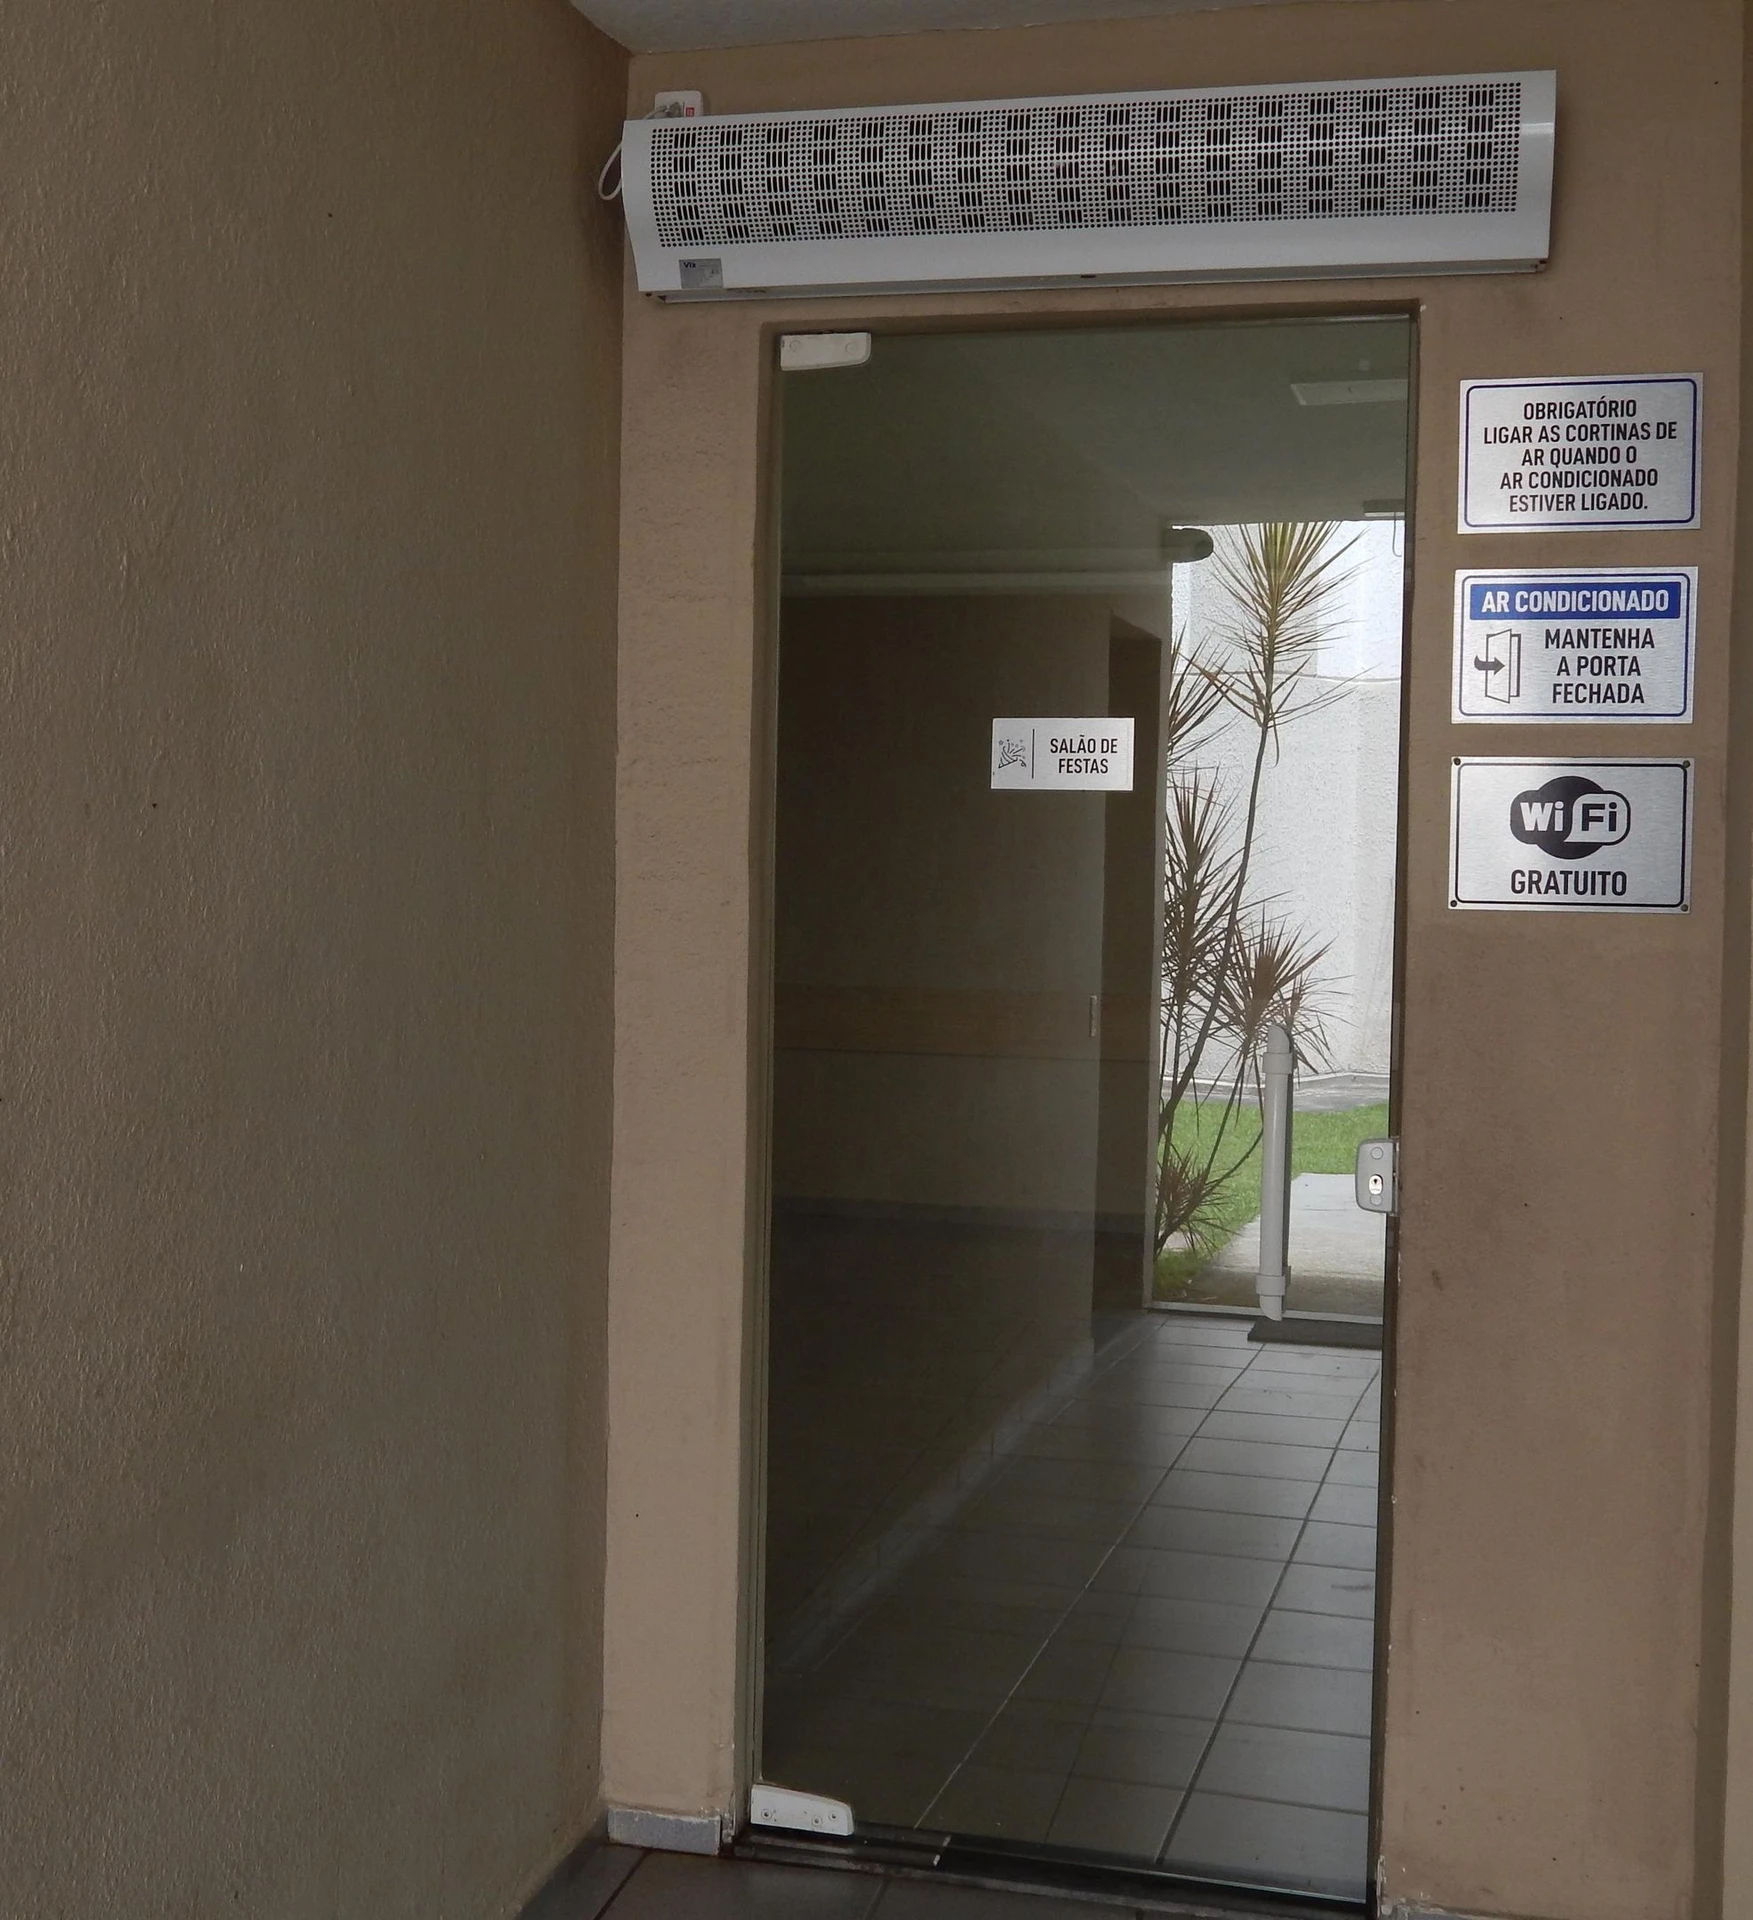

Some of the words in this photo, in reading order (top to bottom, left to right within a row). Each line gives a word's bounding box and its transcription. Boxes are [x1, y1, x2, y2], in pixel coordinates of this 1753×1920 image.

[1524, 396, 1637, 420] OBRIGATÓRIO
[1484, 426, 1533, 444] LIGAR
[1538, 425, 1561, 443] AS
[1565, 422, 1651, 442] CORTINAS
[1656, 421, 1678, 440] DE
[1521, 448, 1544, 466] AR
[1550, 446, 1621, 468] QUANDO
[1626, 446, 1637, 464] O
[1500, 472, 1523, 489] AR
[1528, 469, 1658, 489] CONDICIONADO
[1509, 494, 1575, 512] ESTIVER
[1581, 492, 1648, 511] LIGADO.
[1481, 590, 1509, 613] AR
[1515, 589, 1669, 613] CONDICIONADO
[1545, 628, 1655, 649] MANTENHA
[1557, 656, 1571, 677] A
[1577, 655, 1641, 677] PORTA
[1552, 683, 1645, 704] FECHADA
[1050, 735, 1097, 754] SALÃO
[1101, 738, 1118, 754] DE
[1058, 758, 1109, 774] FESTAS
[1511, 869, 1627, 896] GRATUITO
